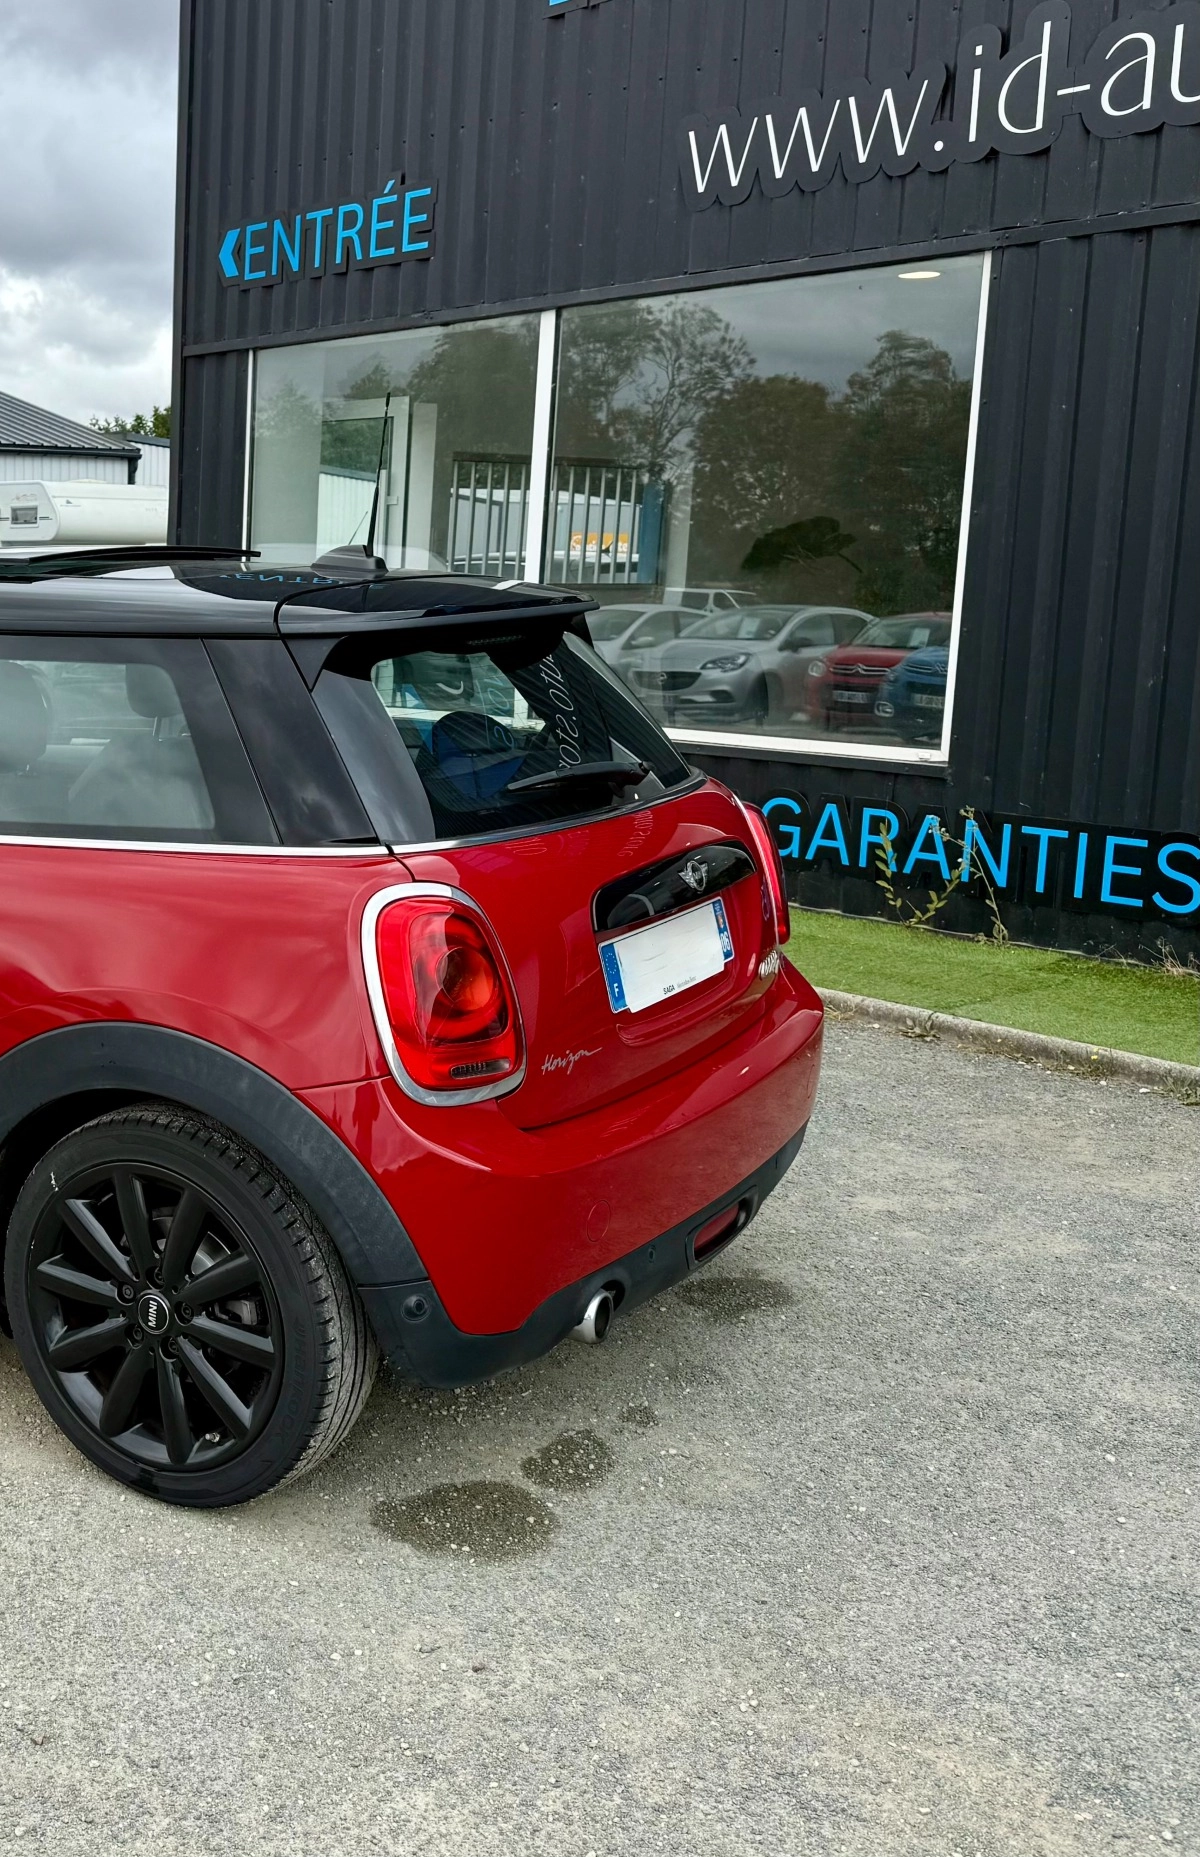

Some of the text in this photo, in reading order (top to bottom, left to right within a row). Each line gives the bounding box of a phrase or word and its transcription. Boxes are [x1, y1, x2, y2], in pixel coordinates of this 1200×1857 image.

[244, 179, 432, 280] ENTRÉE
[761, 797, 1200, 914] GARANTIES
[613, 982, 620, 997] F
[663, 984, 676, 995] SAGA
[541, 1047, 603, 1076] Horizon
[148, 1300, 158, 1328] MINI
